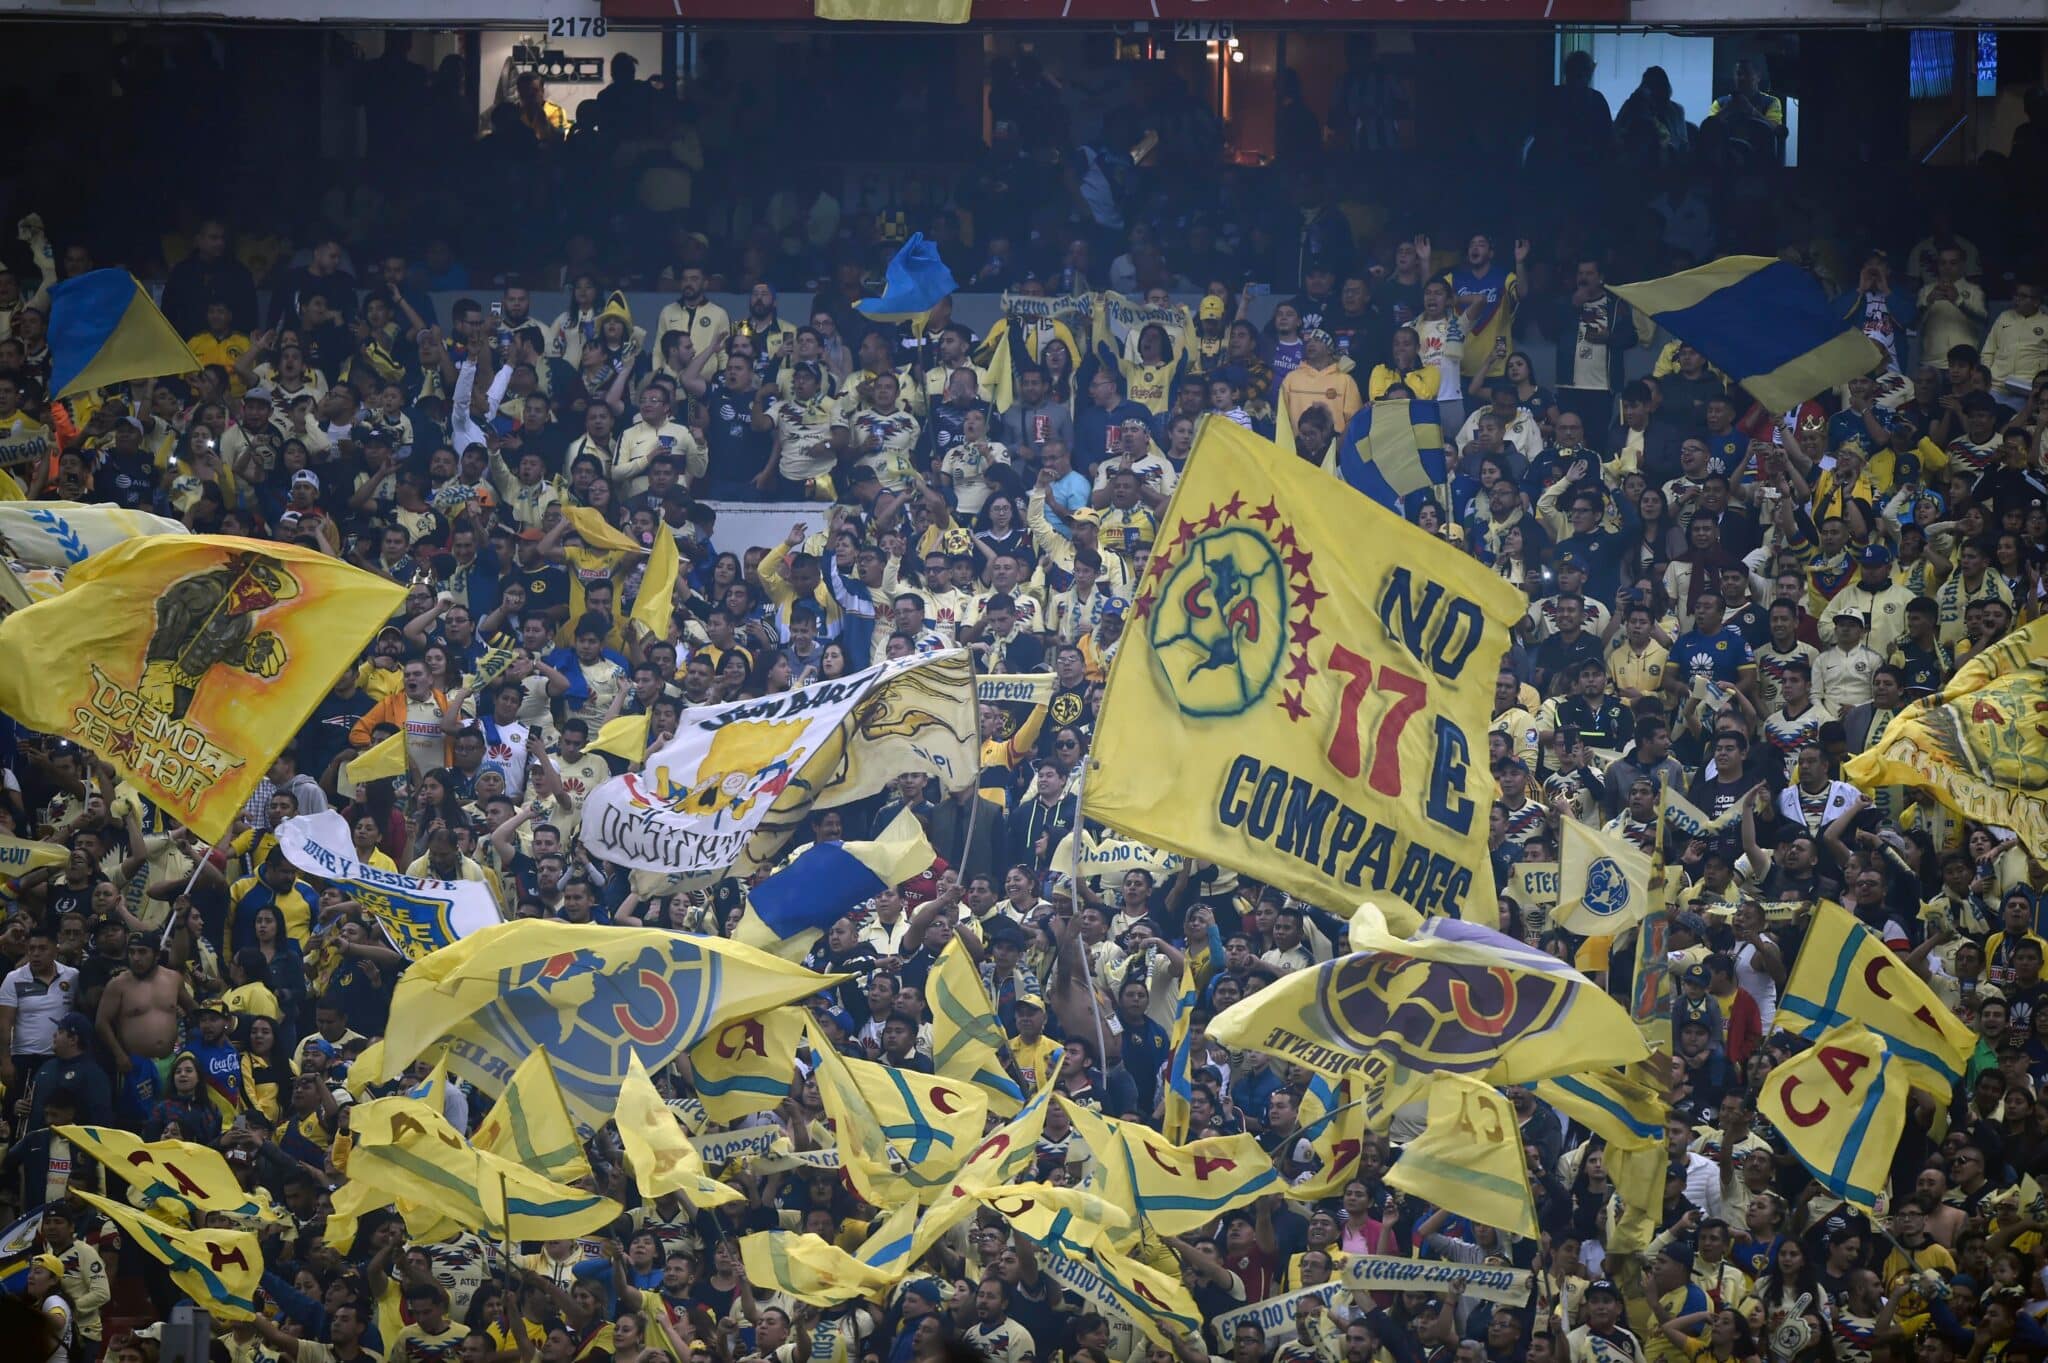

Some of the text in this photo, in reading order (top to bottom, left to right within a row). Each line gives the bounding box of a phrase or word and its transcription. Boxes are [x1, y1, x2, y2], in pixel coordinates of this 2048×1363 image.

[551, 16, 606, 37] 2178
[1176, 22, 1232, 40] 2176
[1380, 565, 1485, 682] NO
[779, 671, 880, 720] BART
[1219, 753, 1474, 920] COMPARES
[715, 1018, 770, 1062] CA
[1779, 1045, 1870, 1128] CA
[459, 1278, 480, 1287] AT&T
[1353, 1258, 1424, 1281] ETERNO
